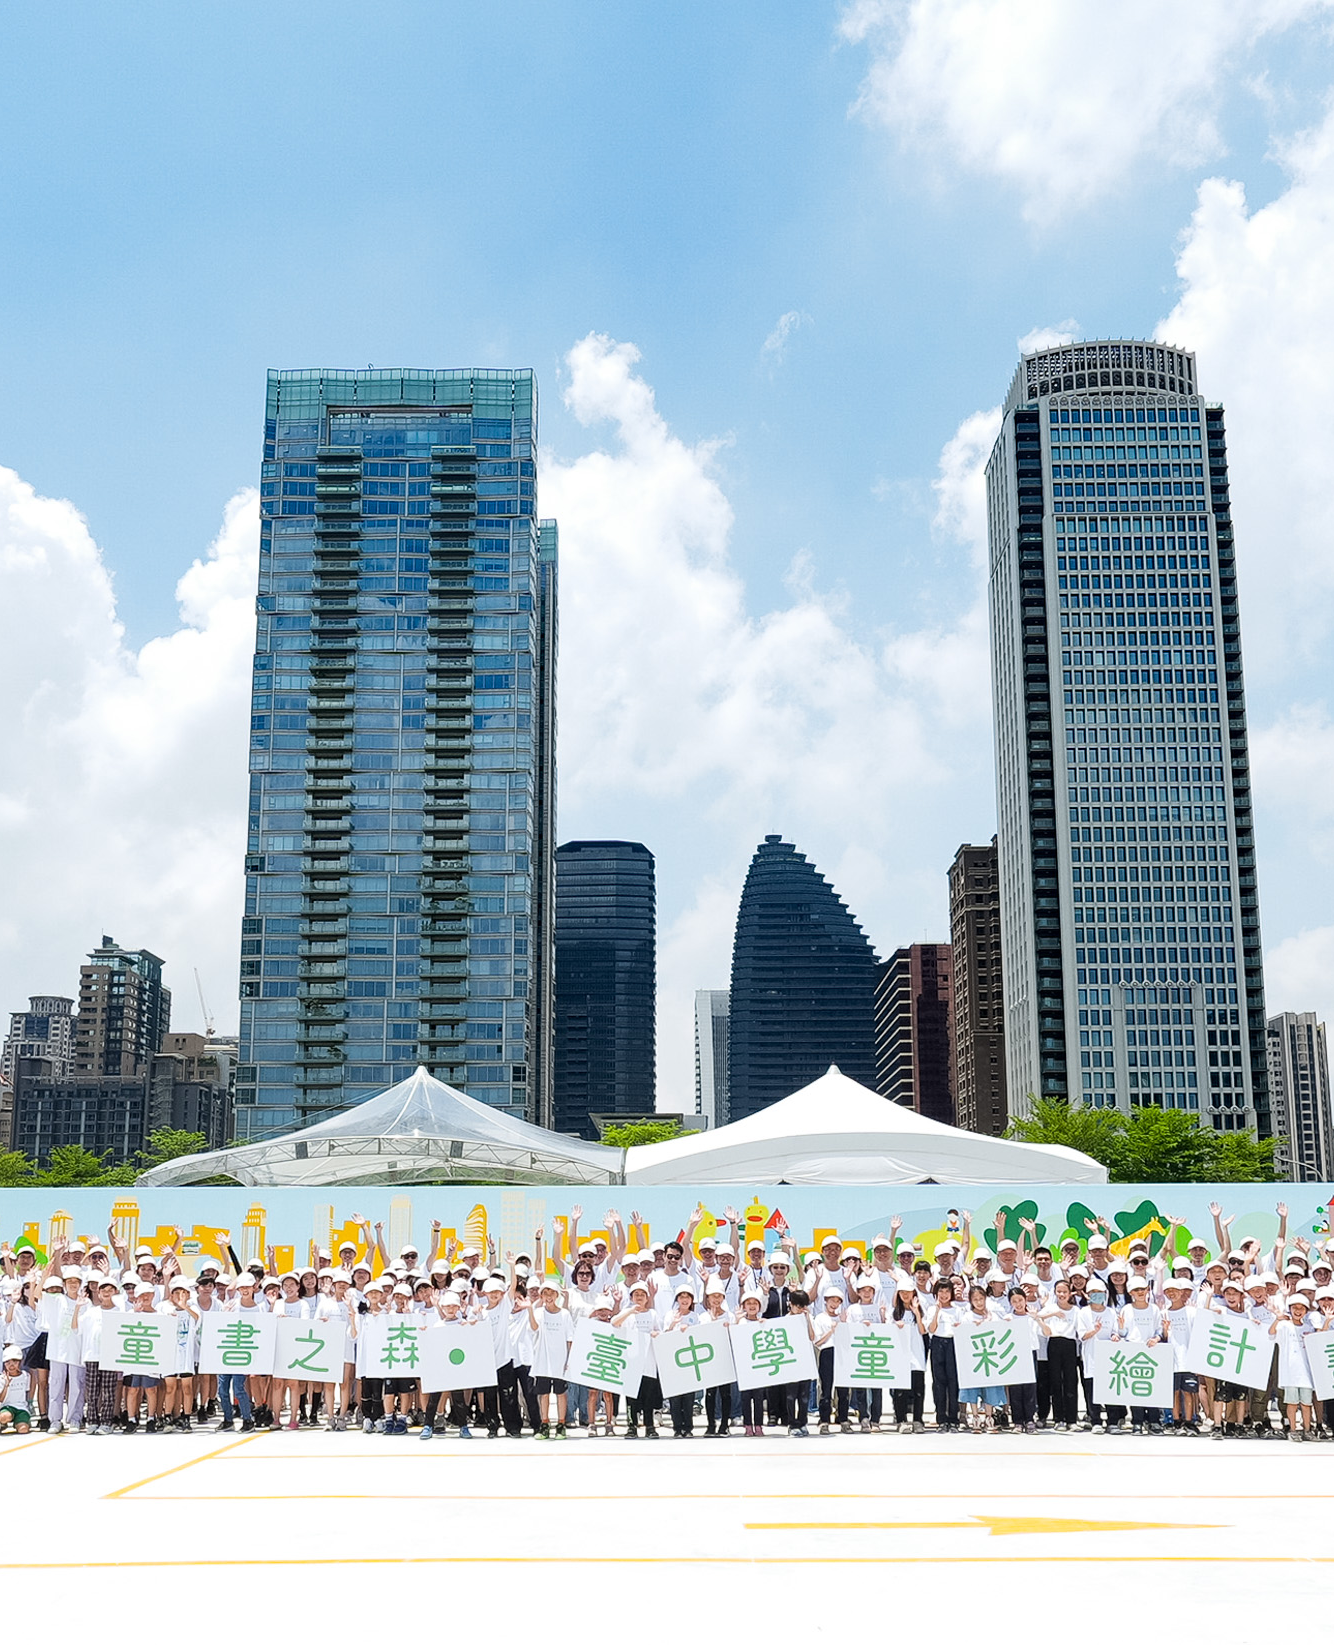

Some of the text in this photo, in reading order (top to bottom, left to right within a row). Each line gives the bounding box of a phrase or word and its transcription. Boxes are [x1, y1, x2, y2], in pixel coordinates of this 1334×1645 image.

[115, 1321, 161, 1366] 童
[217, 1320, 262, 1366] 書
[288, 1329, 330, 1372] 之
[380, 1322, 421, 1370] 森
[581, 1333, 633, 1385] 臺
[674, 1335, 715, 1381] 中
[751, 1328, 797, 1376] 學
[850, 1332, 895, 1380] 童
[970, 1329, 1018, 1377] 彩
[1108, 1350, 1159, 1397] 繪
[1206, 1322, 1256, 1374] 計
